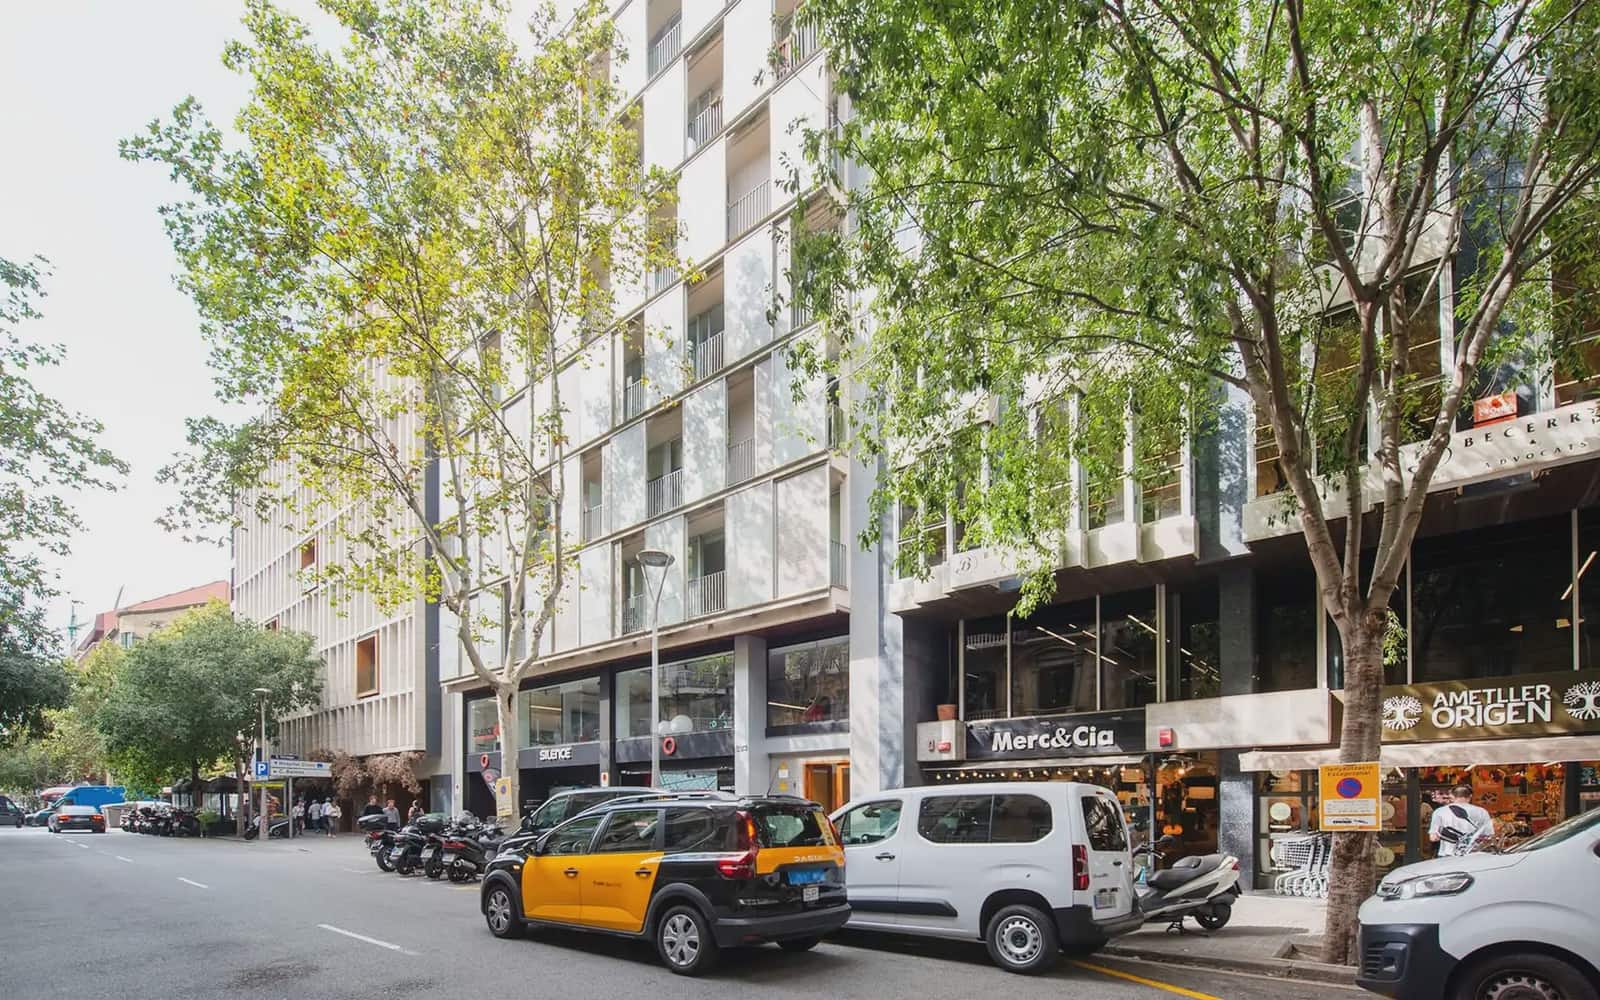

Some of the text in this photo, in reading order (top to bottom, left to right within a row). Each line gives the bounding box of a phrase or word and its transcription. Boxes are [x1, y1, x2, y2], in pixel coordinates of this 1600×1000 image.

[1432, 684, 1552, 708] AMETLLER
[1431, 700, 1552, 729] ORIGEN
[991, 725, 1115, 752] Merc&Cia
[539, 747, 572, 761] SILENCE
[257, 763, 267, 775] P
